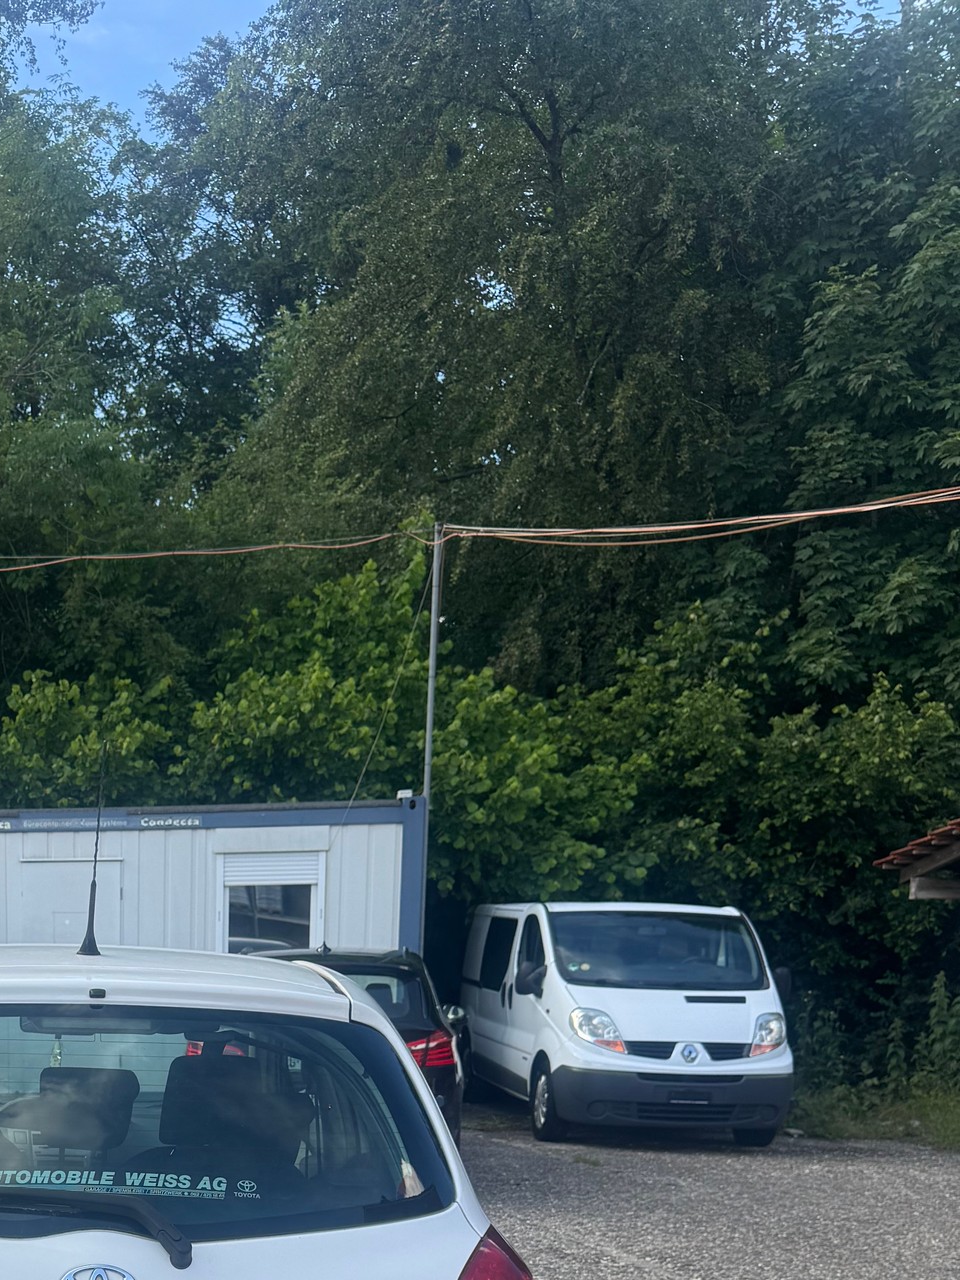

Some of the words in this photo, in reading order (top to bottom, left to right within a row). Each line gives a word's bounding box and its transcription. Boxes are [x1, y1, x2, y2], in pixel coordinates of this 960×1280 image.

[140, 817, 200, 827] Condecta
[125, 1172, 192, 1189] WEISS
[196, 1176, 228, 1191] AG
[233, 1191, 261, 1199] TOYOTA
